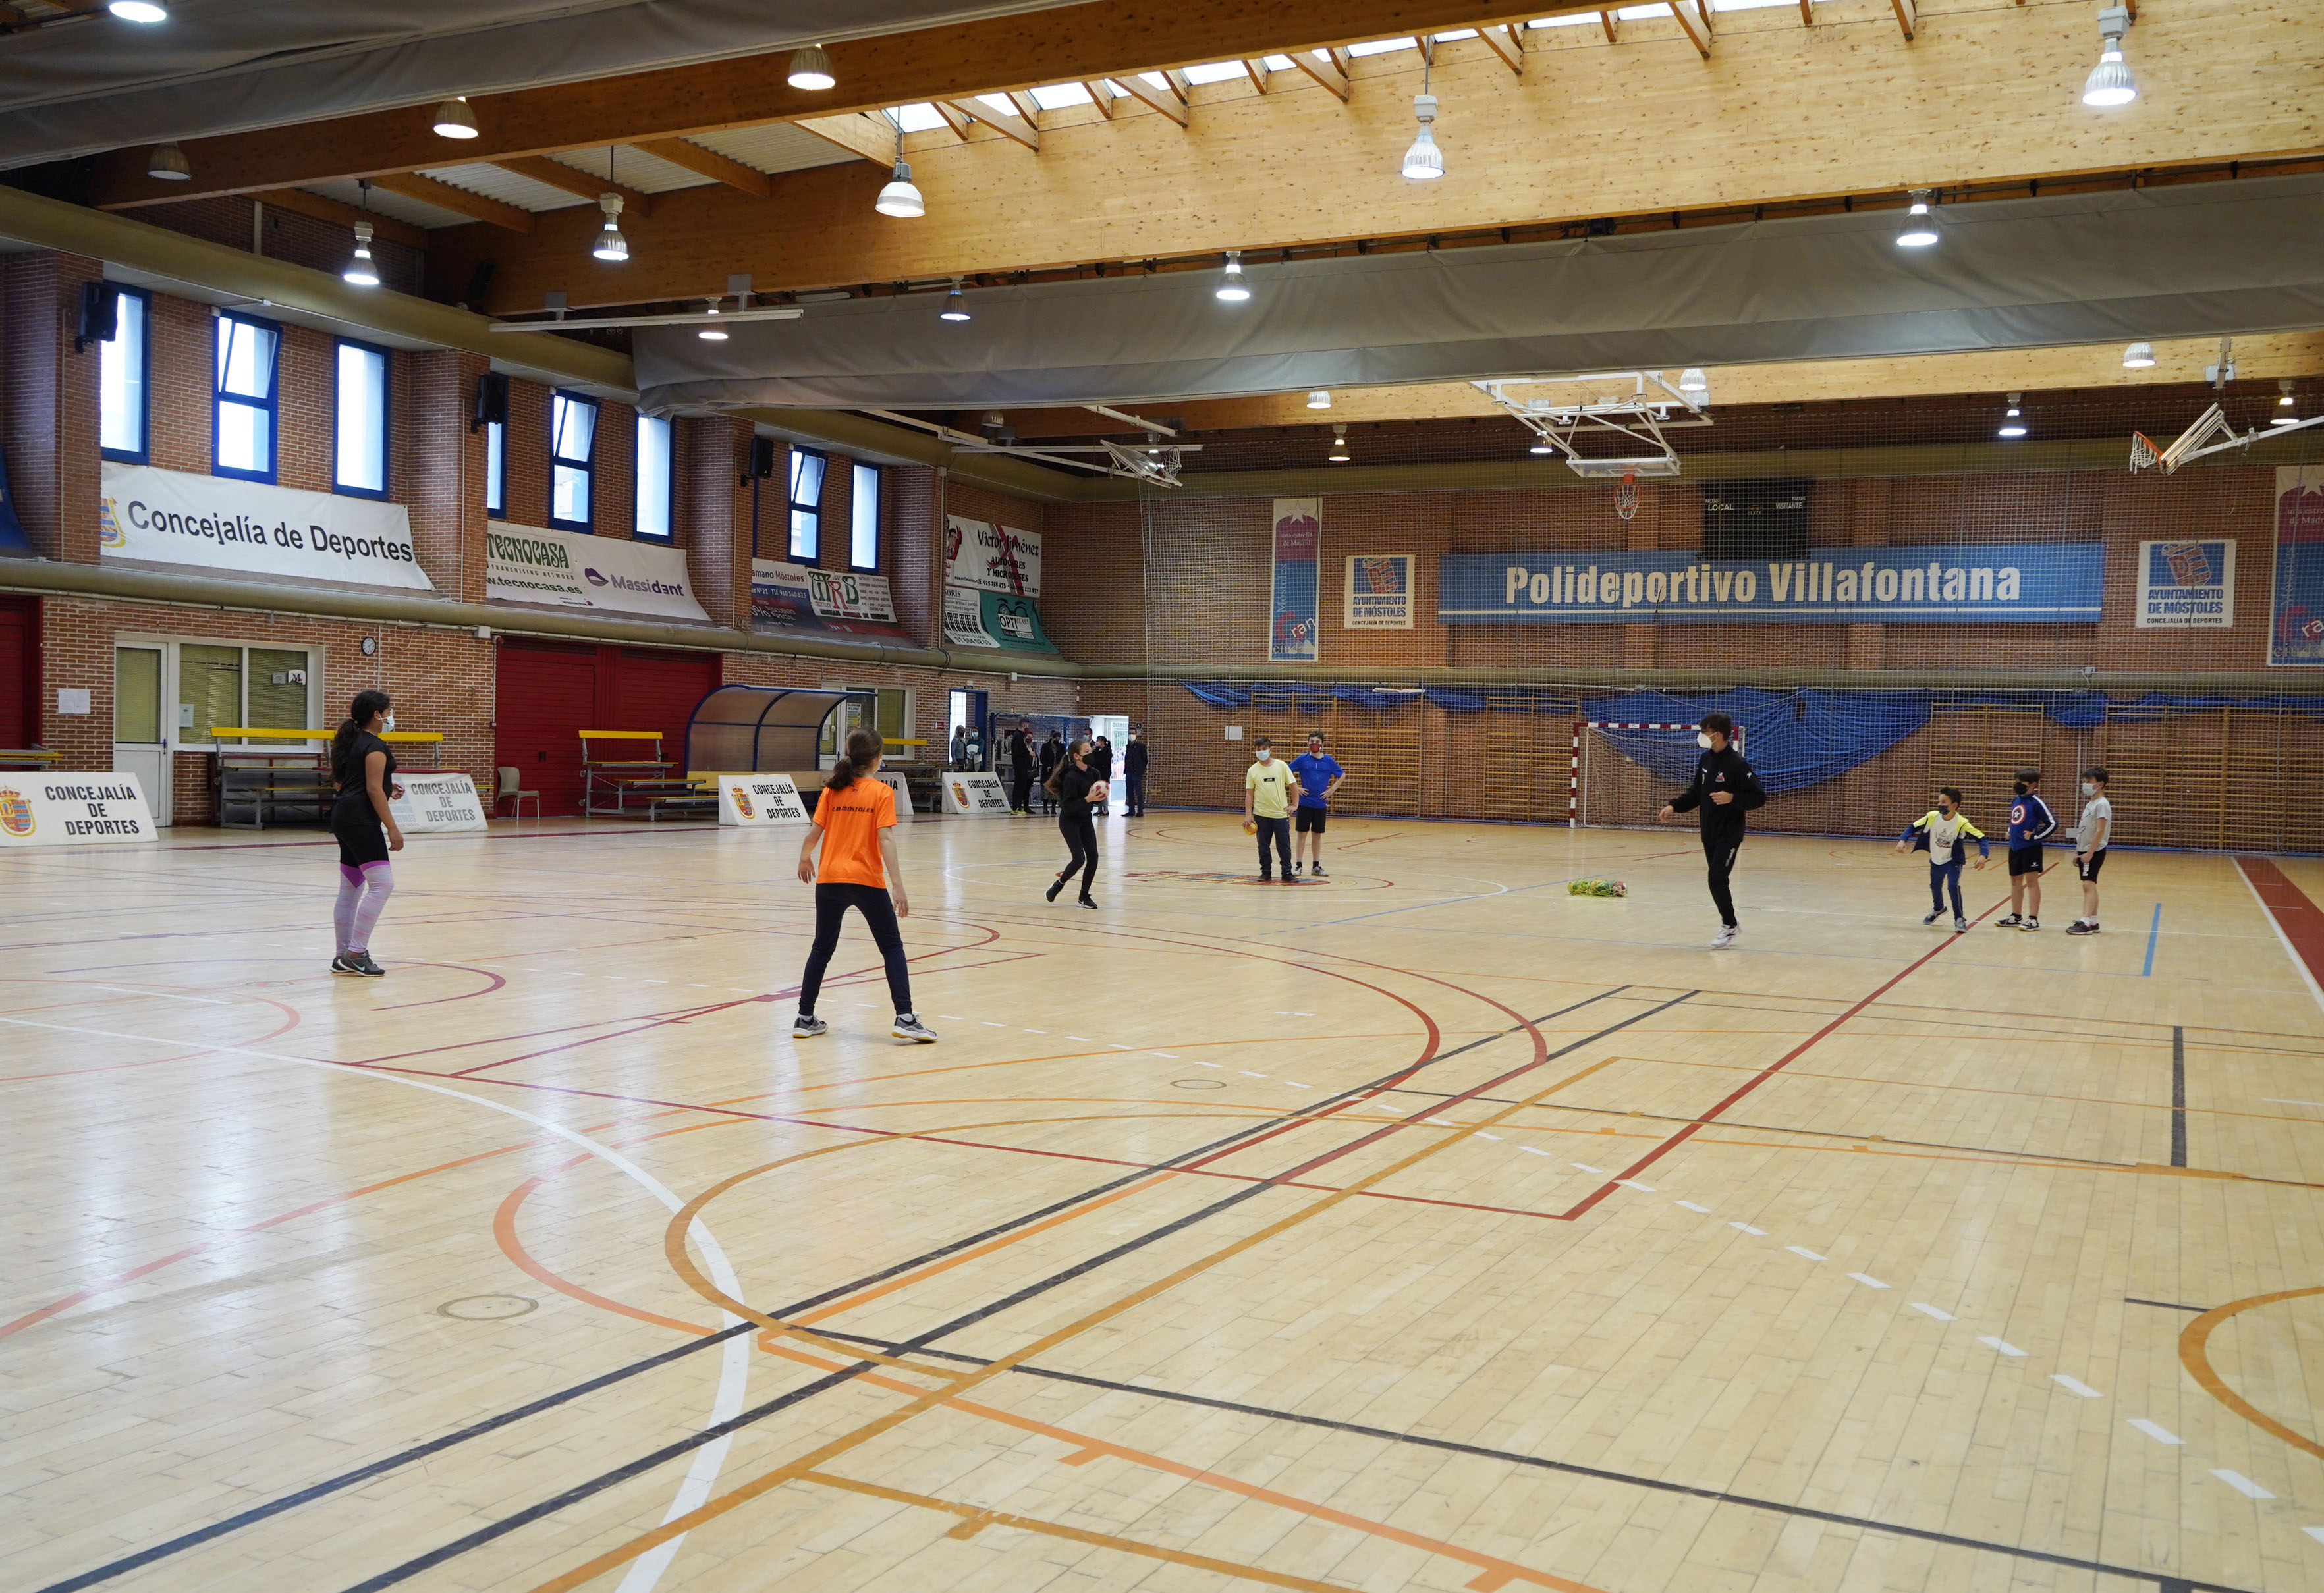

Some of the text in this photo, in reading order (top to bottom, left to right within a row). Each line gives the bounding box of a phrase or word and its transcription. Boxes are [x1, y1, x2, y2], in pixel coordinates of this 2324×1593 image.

[128, 501, 413, 562] Concejalía de Deportes
[487, 533, 570, 569] TECNOCASA
[491, 564, 575, 580] FRANCHISING NETWORK
[1506, 562, 2020, 608] Polideportivo Villafontana
[1353, 596, 1406, 605] AYUNTAMIENTO
[2147, 589, 2223, 600] AYUNTAMIENTO
[1353, 605, 1406, 617] DE MÓSTOLES
[2147, 600, 2223, 614] DE MÓSTOLES
[411, 780, 472, 795] CONCEJALÍA
[752, 782, 795, 794] CONCEJALÍA
[967, 778, 1000, 788] CONCEJALÍA
[45, 784, 136, 800] CONCEJALÍA
[439, 796, 453, 808] DE
[773, 796, 784, 806] DE
[978, 799, 1005, 808] DEPORTES
[88, 803, 107, 817] DE
[426, 809, 476, 822] DEPORTES
[766, 807, 801, 819] DEPORTES
[65, 820, 140, 835] DEPORTES
